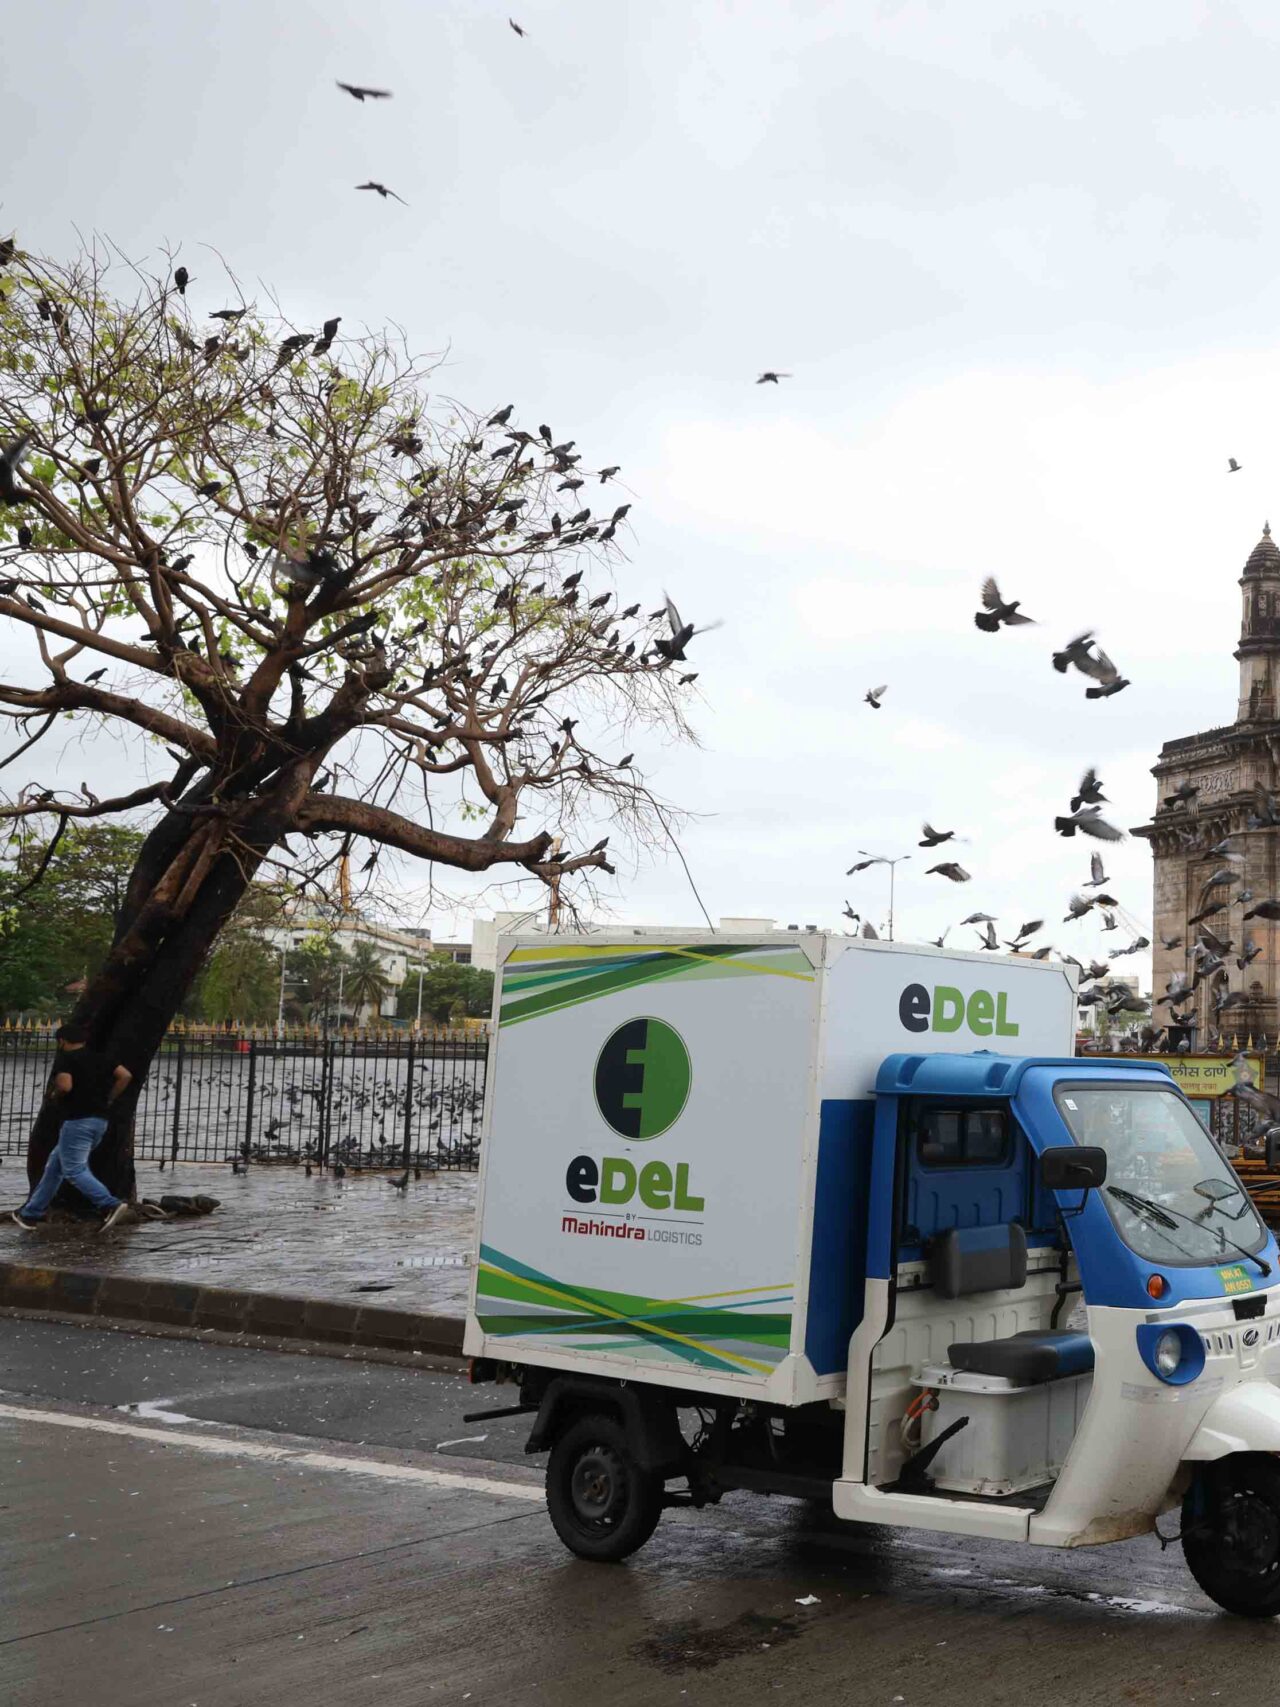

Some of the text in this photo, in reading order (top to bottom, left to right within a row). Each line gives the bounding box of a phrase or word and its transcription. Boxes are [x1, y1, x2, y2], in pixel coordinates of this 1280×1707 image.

[899, 983, 1019, 1037] eDeL
[1203, 1064, 1228, 1078] ठाणे
[566, 1155, 705, 1212] eDeL
[625, 1213, 637, 1222] BY
[648, 1229, 703, 1246] LOGISTICS
